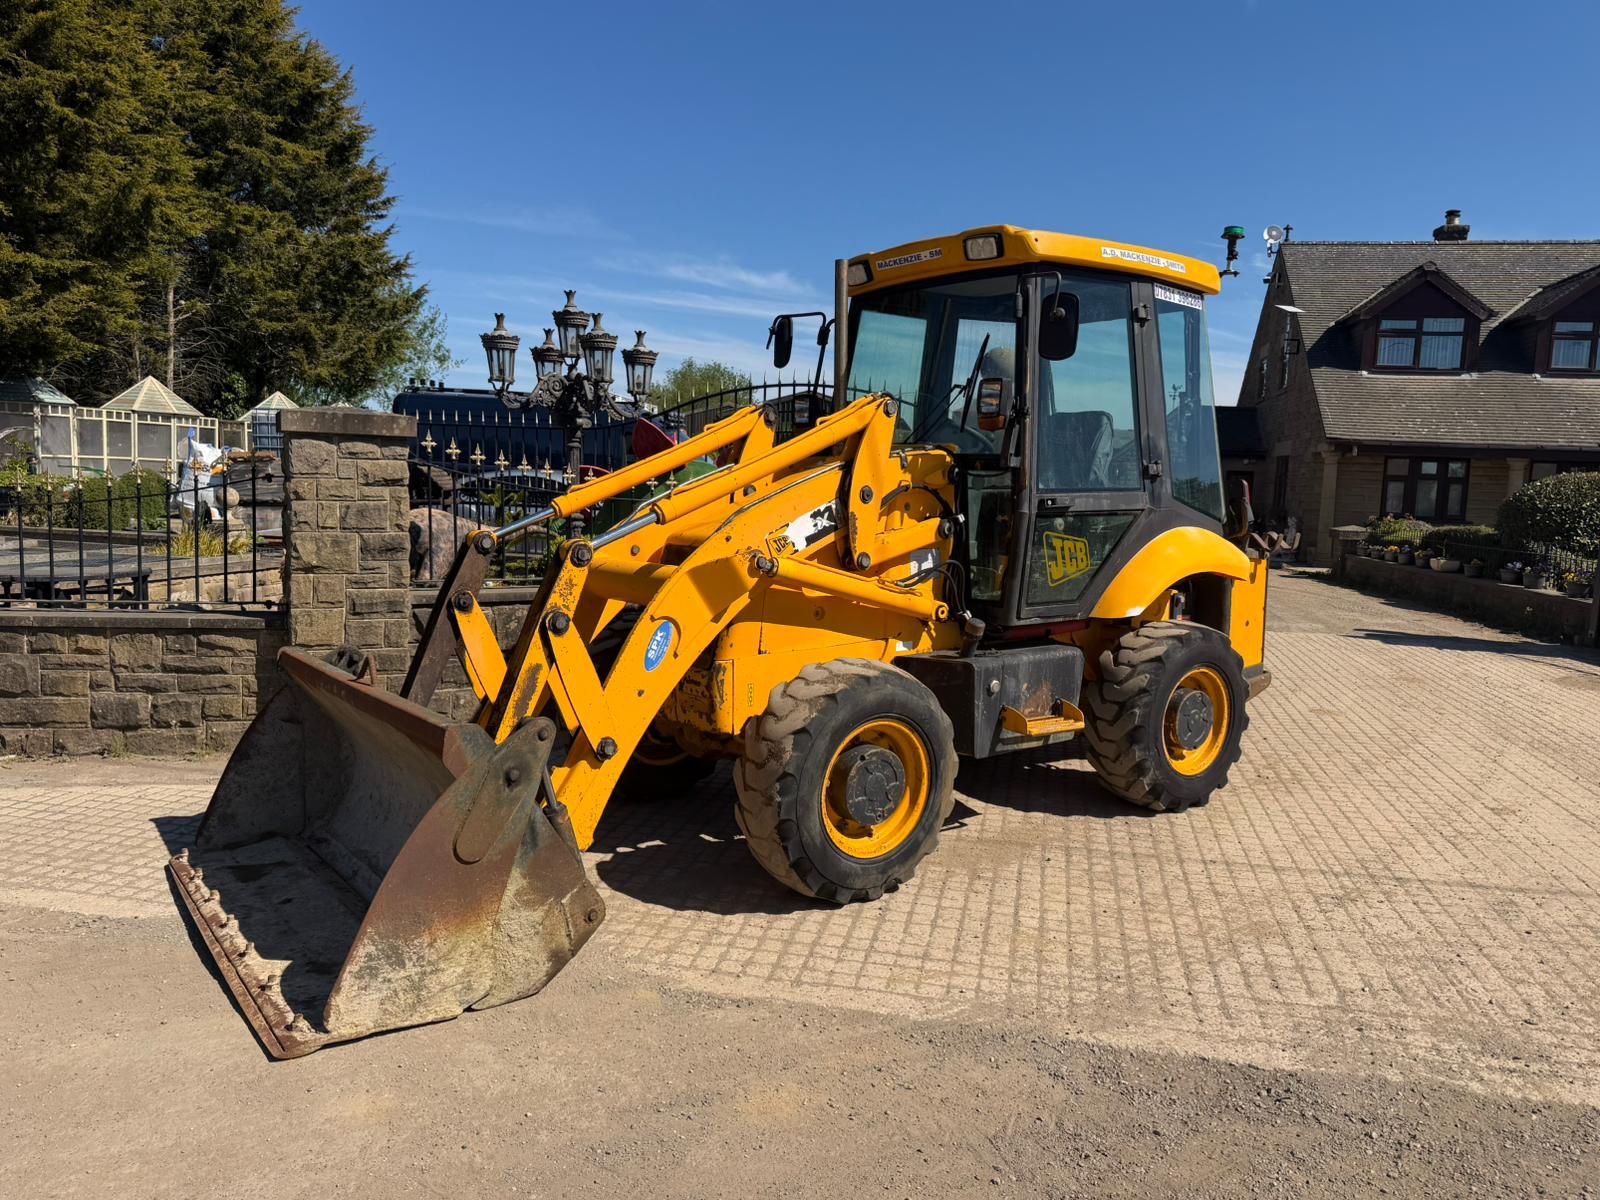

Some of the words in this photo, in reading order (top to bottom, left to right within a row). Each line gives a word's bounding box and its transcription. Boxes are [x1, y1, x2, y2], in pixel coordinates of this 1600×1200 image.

[878, 254, 922, 269] MACKENZIE
[1103, 248, 1119, 257] A.D.
[1120, 250, 1162, 265] MACKENZIE
[1166, 260, 1185, 271] SMITH
[1049, 537, 1088, 580] JCB
[648, 630, 666, 659] SPK
